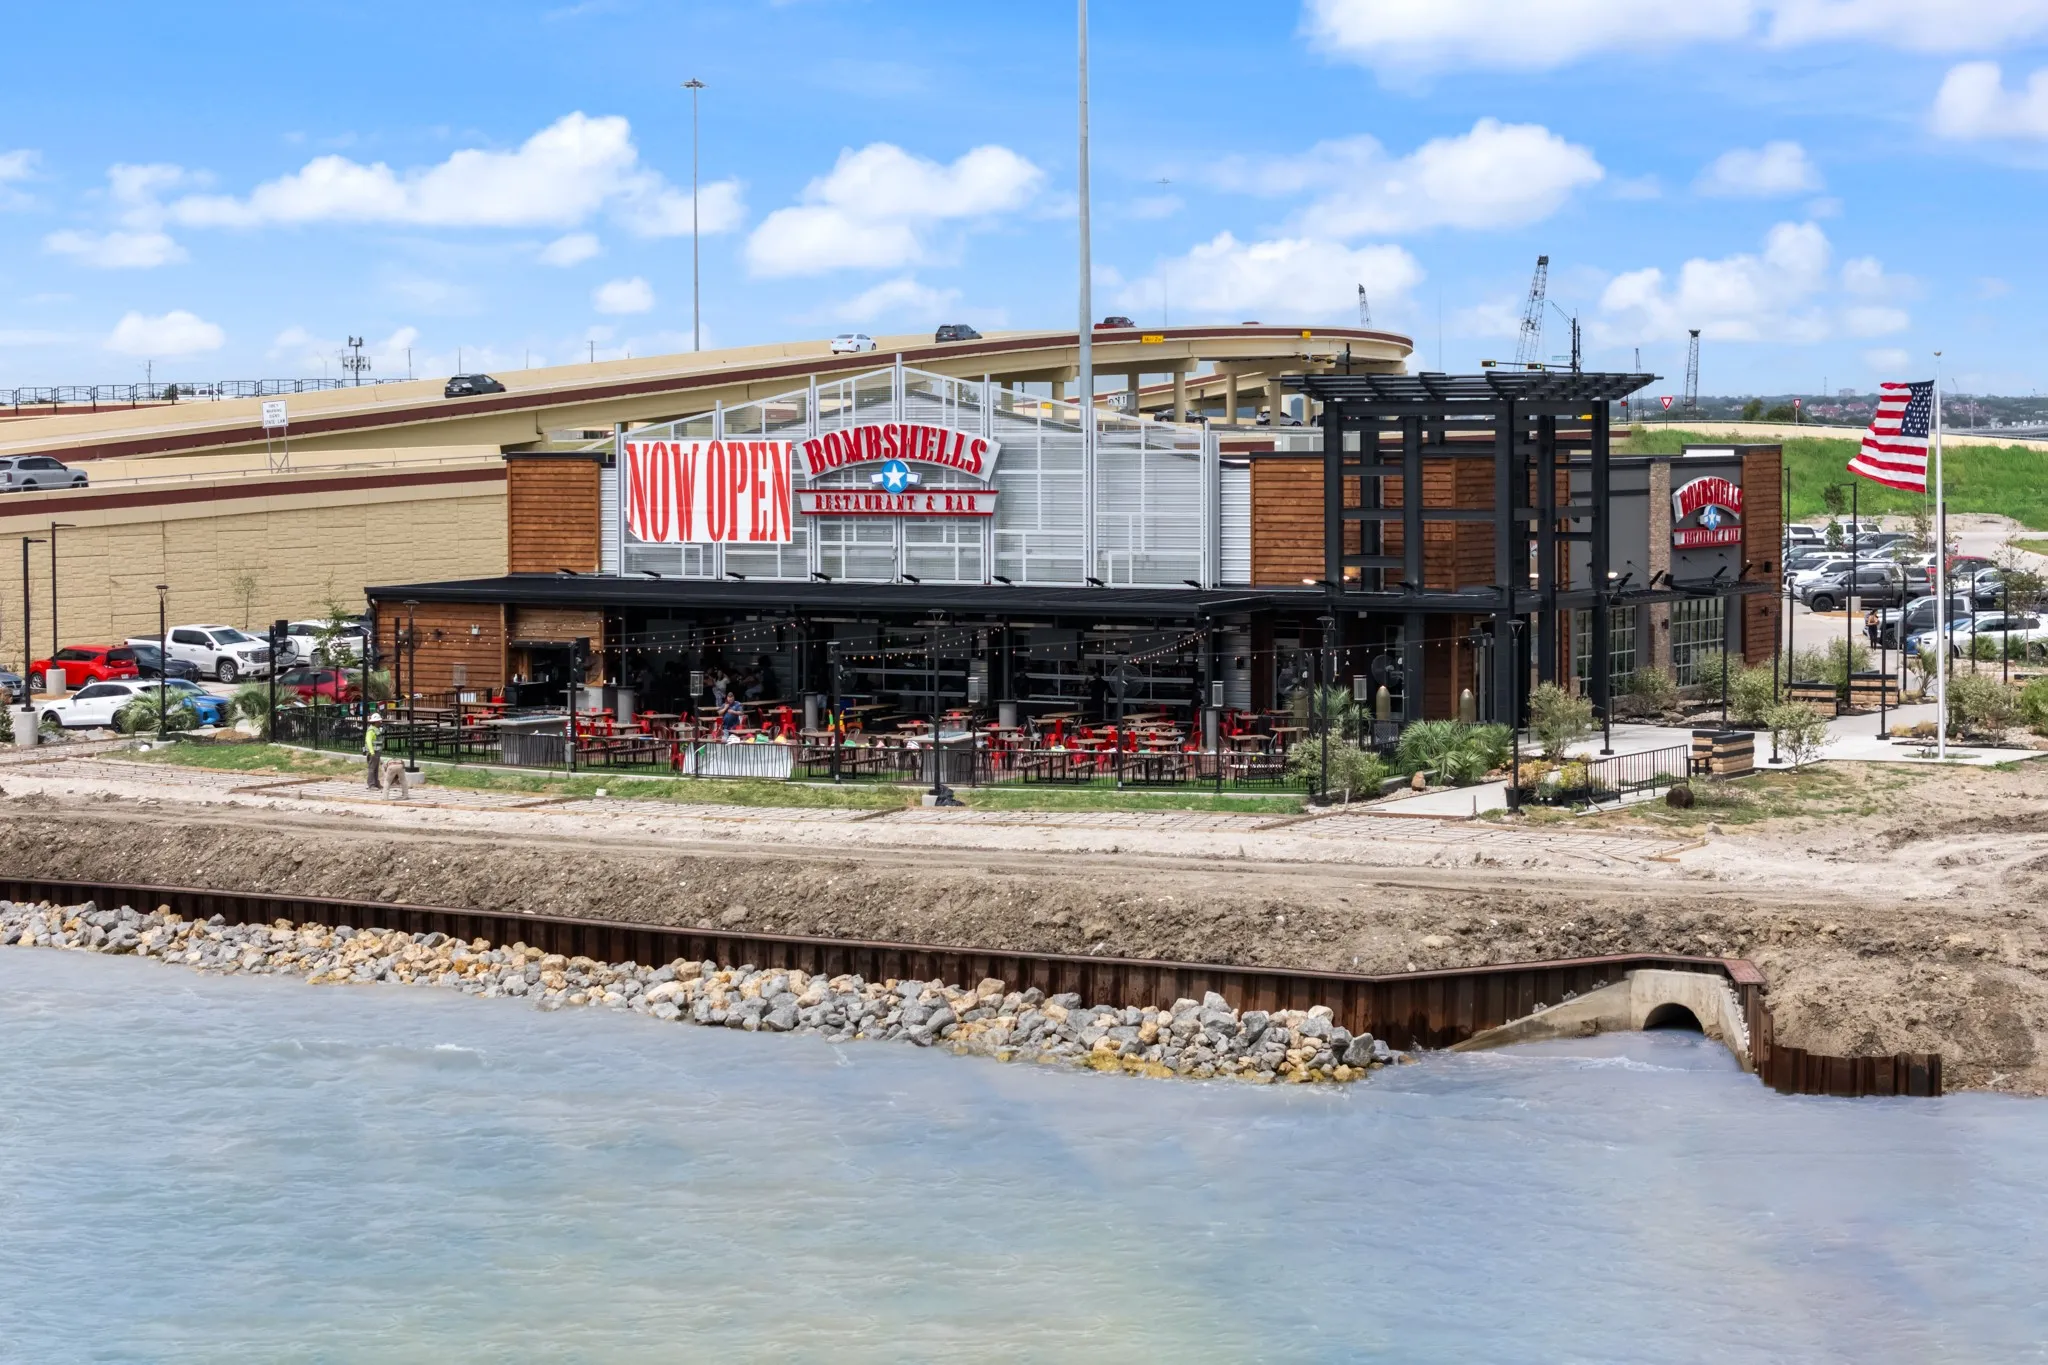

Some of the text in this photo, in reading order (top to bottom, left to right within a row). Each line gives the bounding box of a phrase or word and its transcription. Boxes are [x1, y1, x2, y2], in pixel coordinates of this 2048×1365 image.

[802, 423, 988, 475] BOMBSHELLS
[626, 440, 793, 543] NOW OPEN
[815, 494, 977, 511] RESTAURANT & BAR
[1680, 477, 1743, 518] BOMBSHELLS
